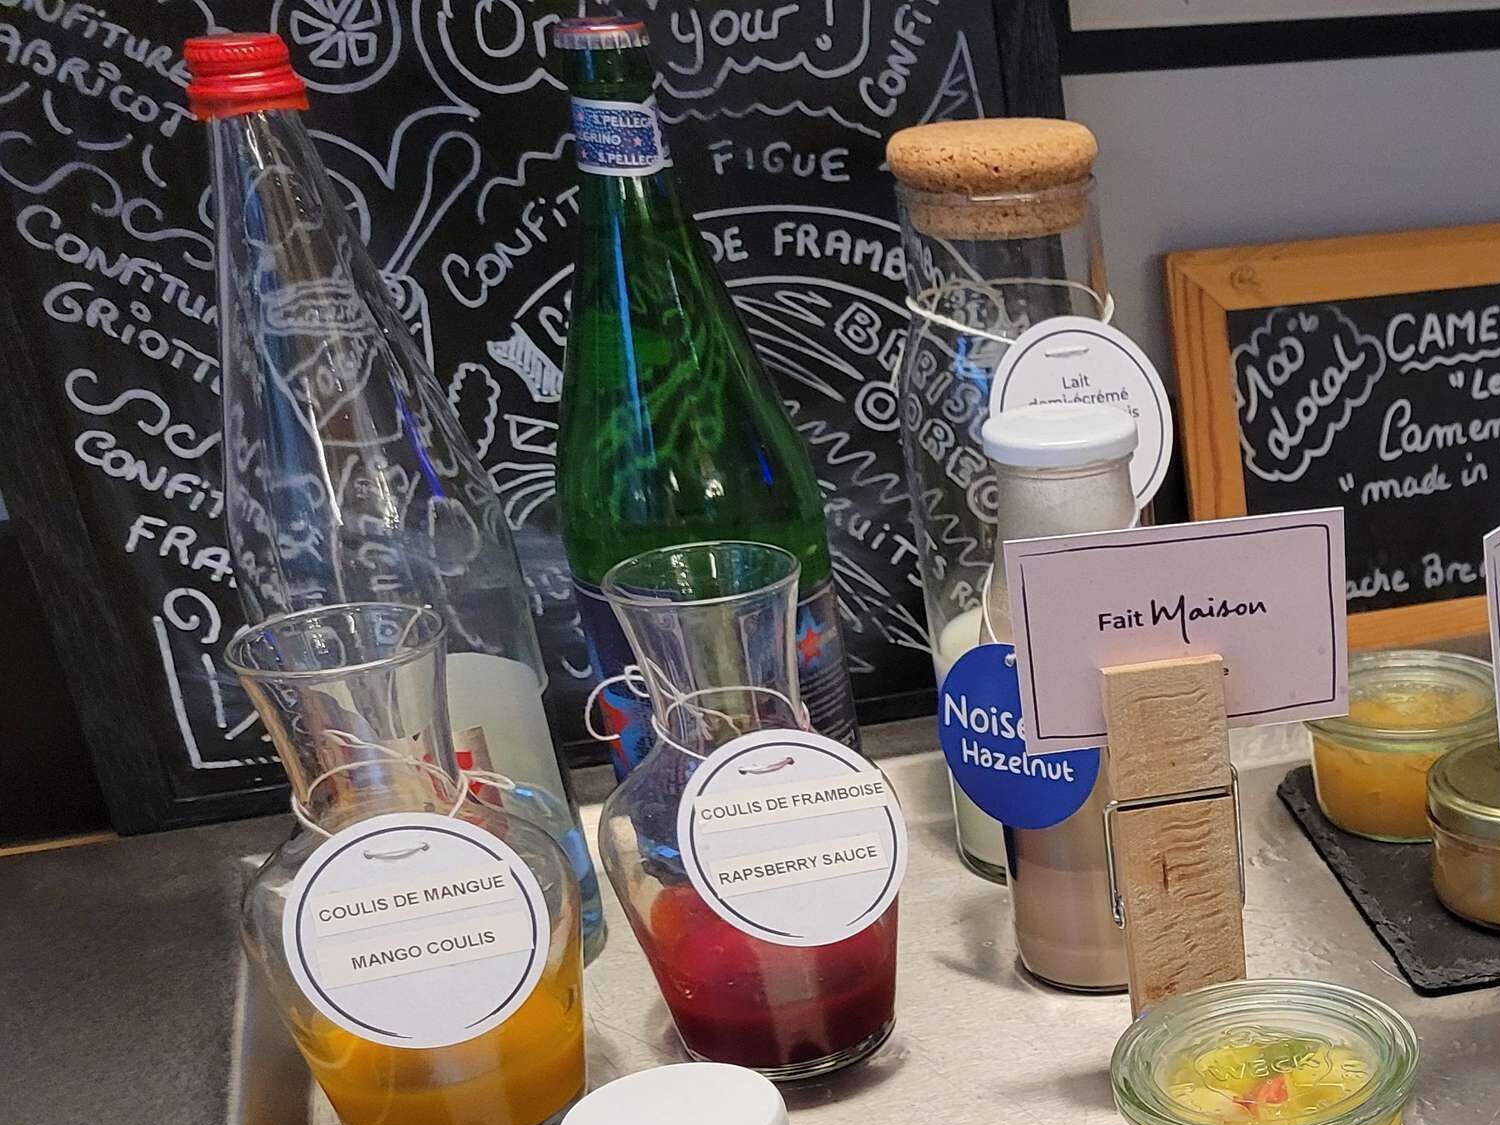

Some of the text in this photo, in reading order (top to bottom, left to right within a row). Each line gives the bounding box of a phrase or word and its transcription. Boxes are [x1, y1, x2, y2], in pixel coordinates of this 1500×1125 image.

[709, 139, 850, 182] FIGUE
[42, 281, 221, 396] GRIOTT
[1062, 373, 1091, 390] Lait
[1460, 451, 1490, 487] in
[124, 514, 238, 589] FRA
[1098, 594, 1268, 645] Fait Maison
[961, 737, 1075, 783] Hazelnut
[700, 782, 885, 821] COULIS DE FRAMBOISE
[718, 845, 878, 886] RAPSBERRY SAUCE
[318, 874, 506, 923] COULIS DE MANGUE
[351, 930, 497, 971] MANGO COULIS
